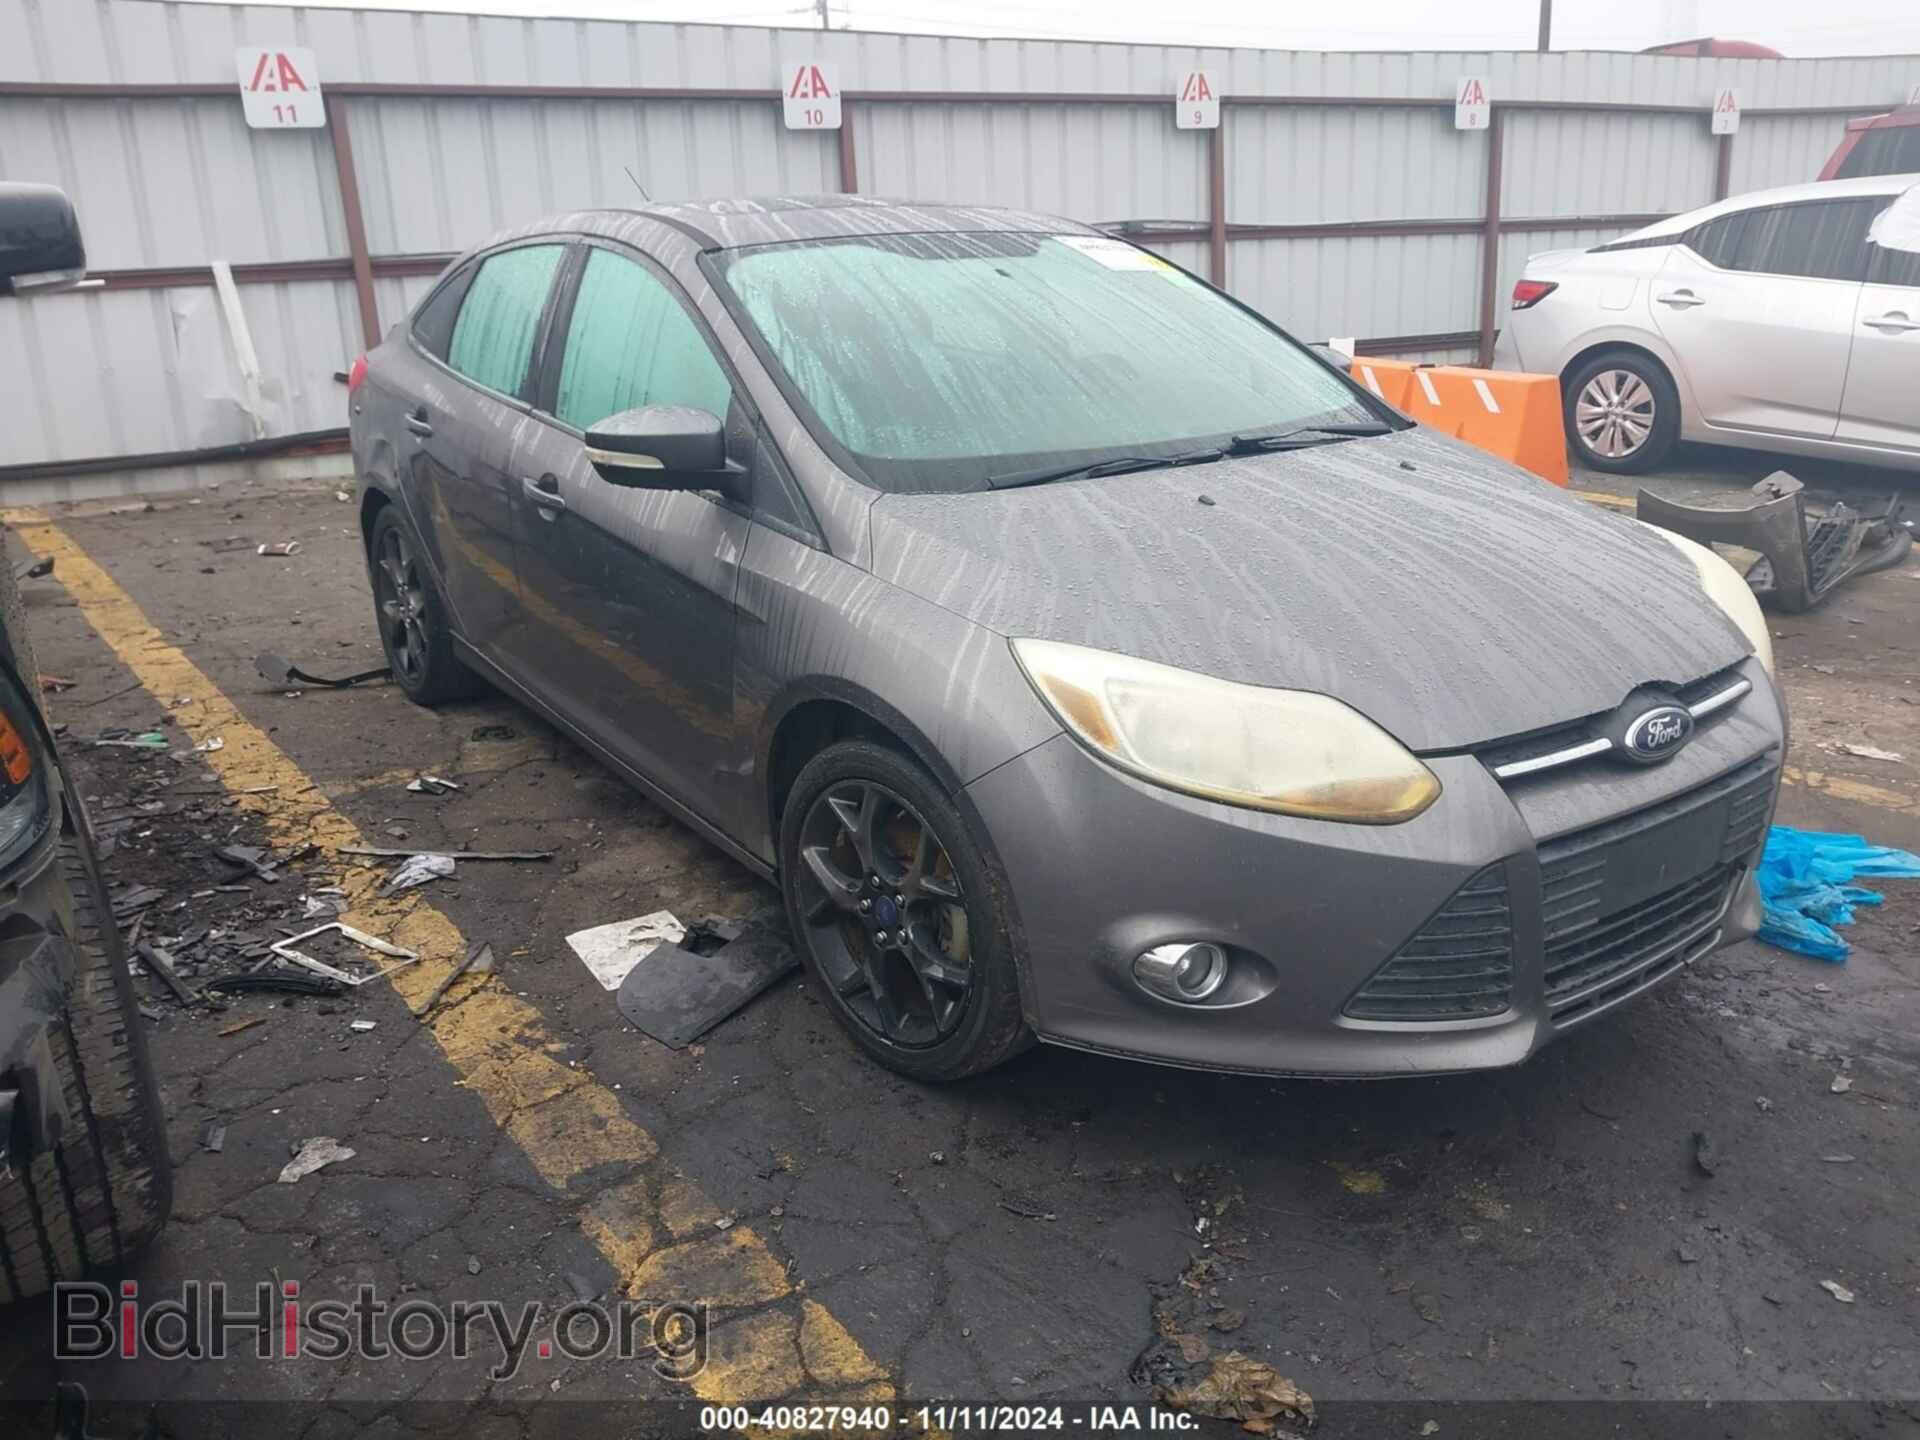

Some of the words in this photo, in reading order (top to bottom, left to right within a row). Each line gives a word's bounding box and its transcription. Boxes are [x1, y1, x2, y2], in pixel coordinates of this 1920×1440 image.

[273, 104, 298, 123] 11
[805, 109, 824, 126] 10
[1194, 110, 1203, 125] 9
[1647, 716, 1681, 748] Ford
